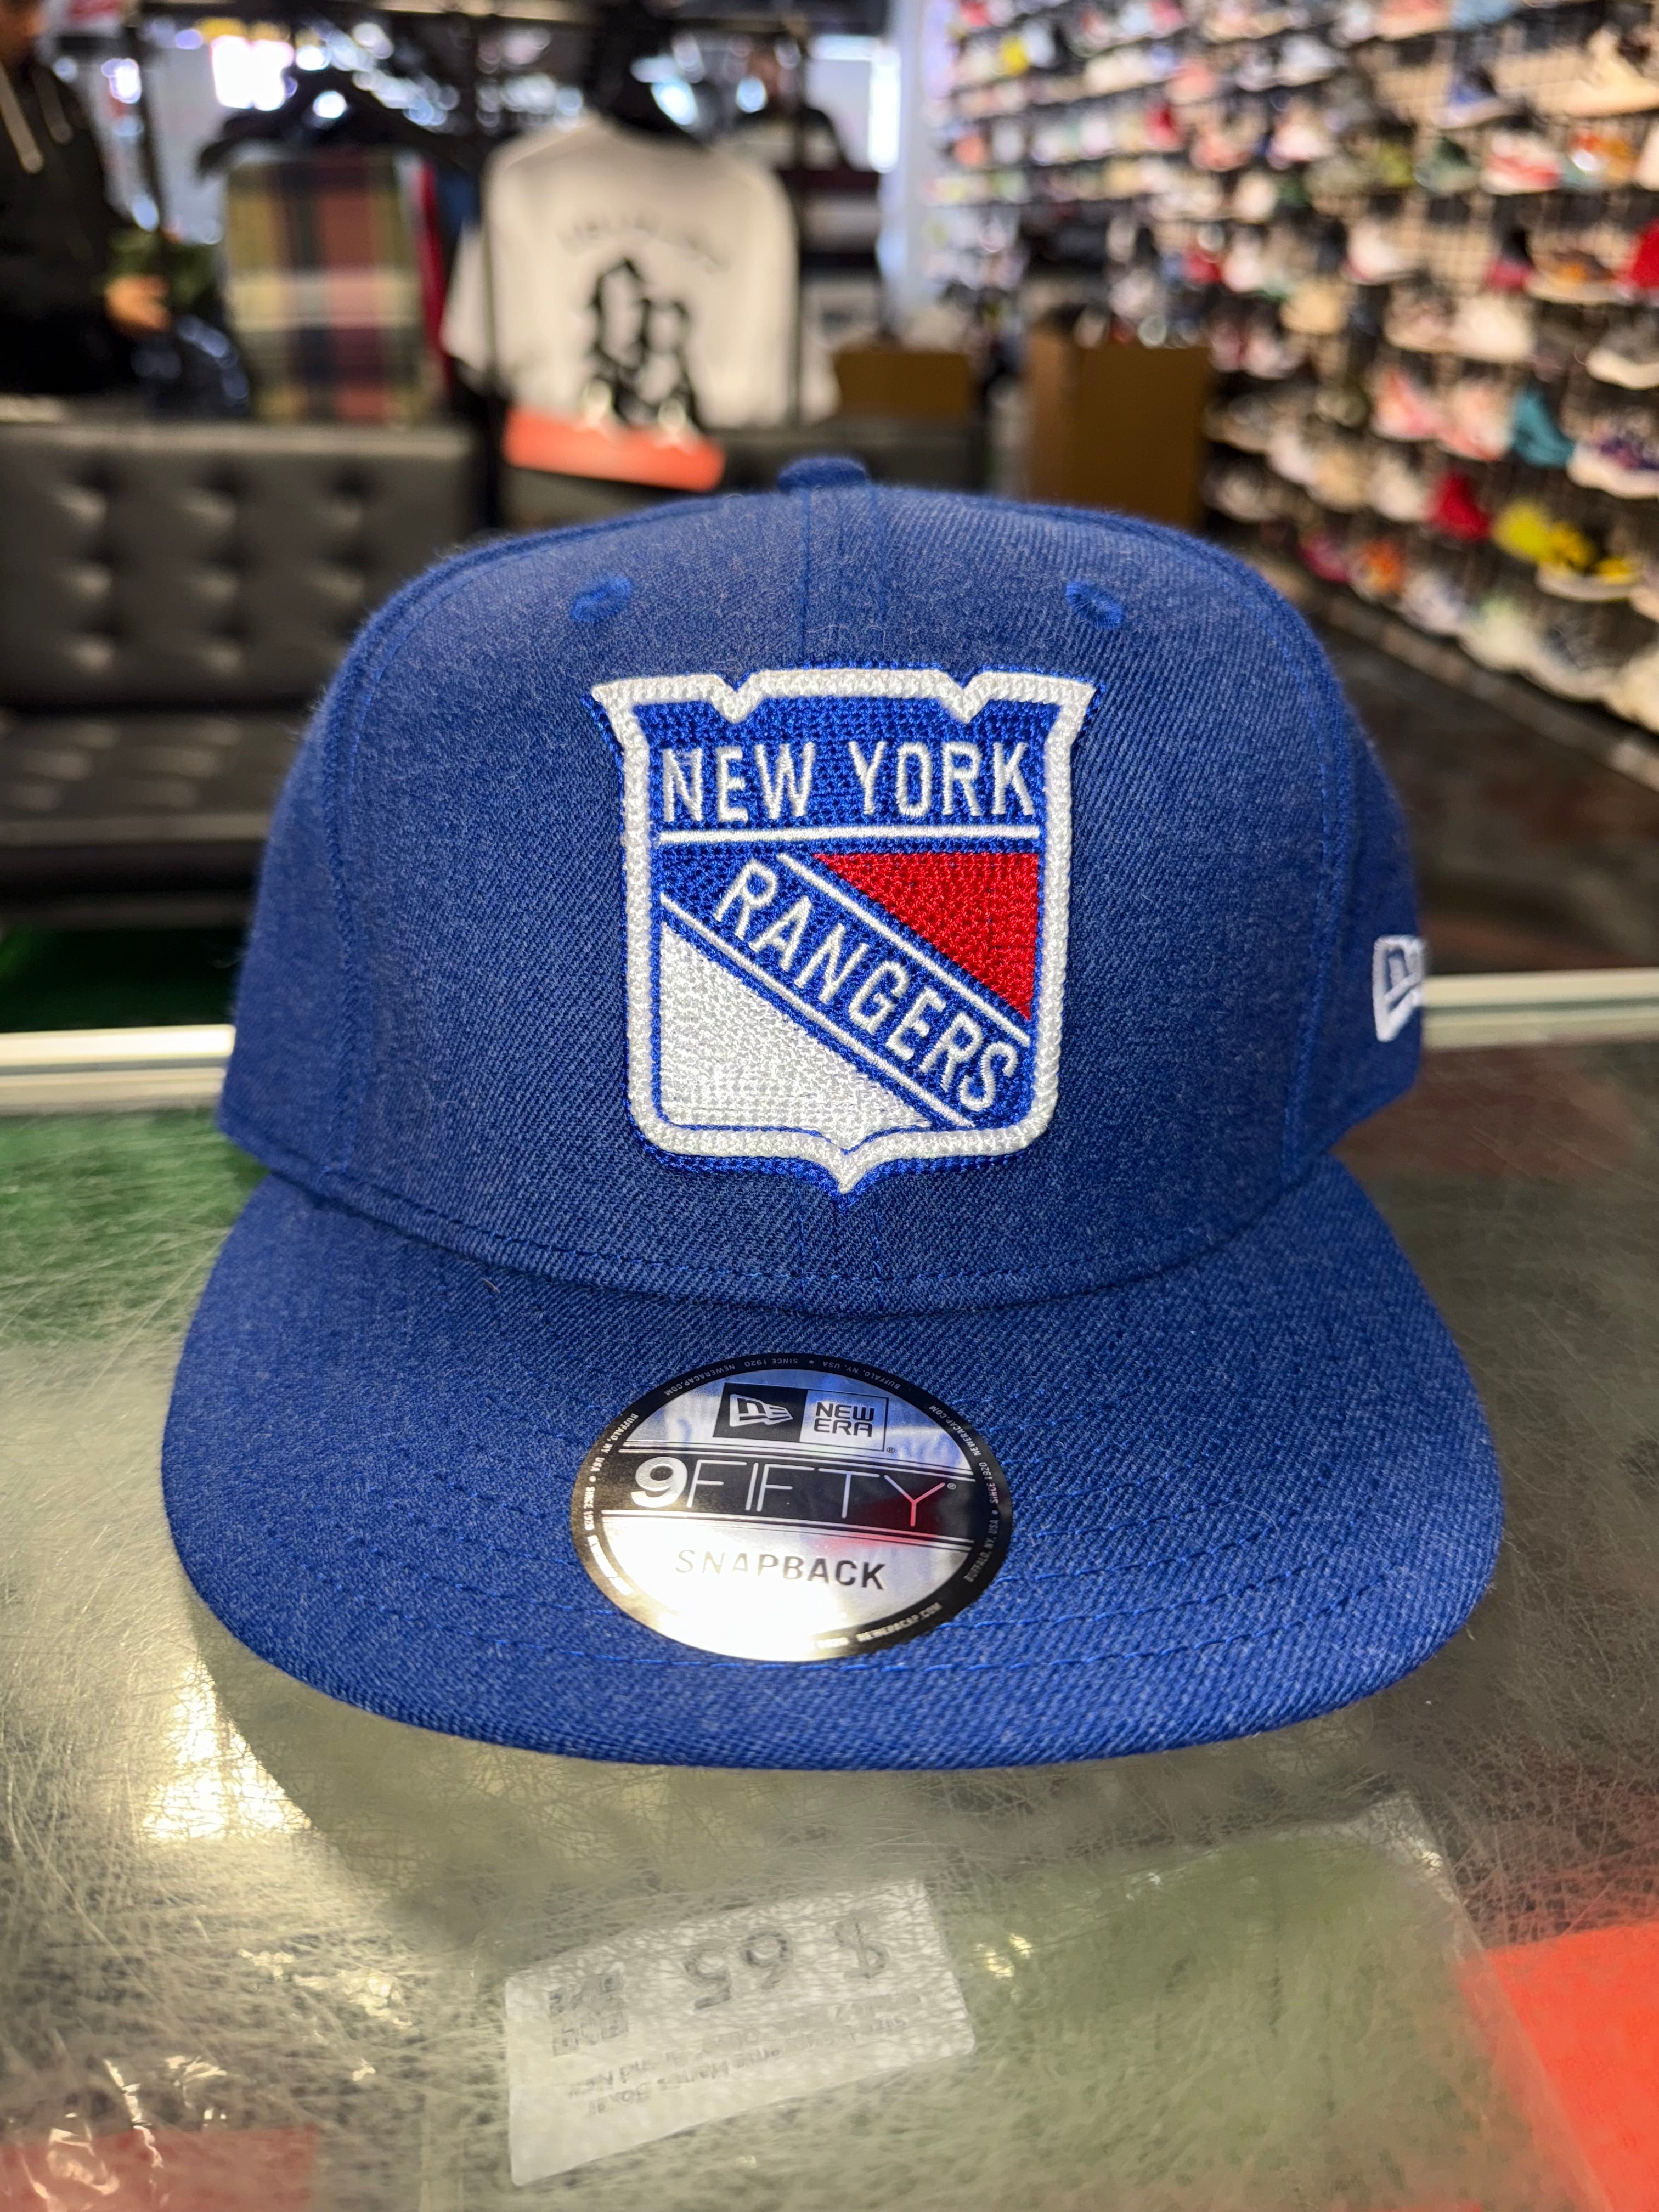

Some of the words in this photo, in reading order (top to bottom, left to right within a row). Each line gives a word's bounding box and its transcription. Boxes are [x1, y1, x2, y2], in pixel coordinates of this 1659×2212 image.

[662, 742, 816, 822] NEW
[849, 741, 1034, 817] YORK
[712, 860, 1017, 1111] RANGERS
[664, 1364, 736, 1396] NEWERACAP.COM
[744, 1359, 767, 1367] 1920
[823, 1360, 840, 1369] USA
[814, 1417, 872, 1437] ERA
[816, 1402, 874, 1422] NEW
[929, 1404, 981, 1457] NEWERACAP.COM
[630, 1456, 946, 1527] 9FIFTY
[675, 1549, 887, 1590] SNAPBACK
